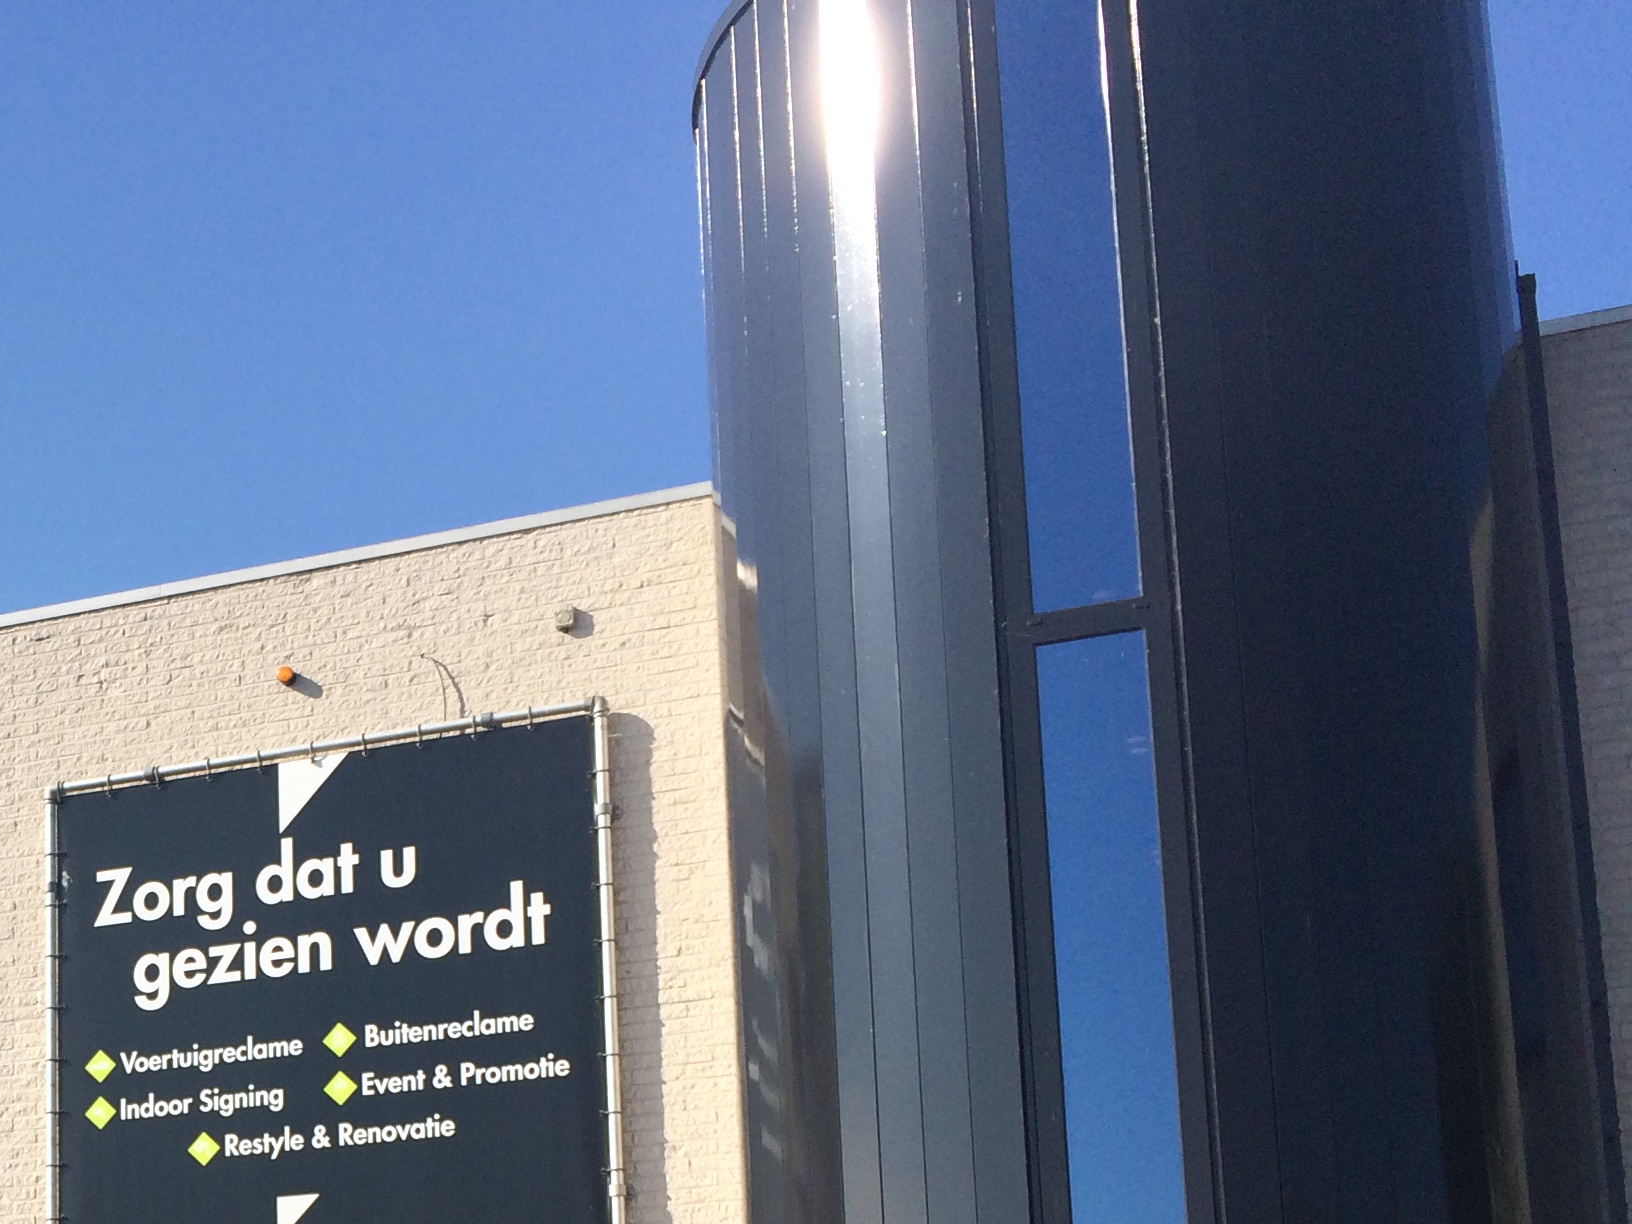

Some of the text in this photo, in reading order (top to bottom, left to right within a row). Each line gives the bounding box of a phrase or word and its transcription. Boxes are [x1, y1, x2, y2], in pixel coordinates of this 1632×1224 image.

[93, 837, 416, 931] Zorg dat u
[133, 880, 552, 1011] gezien wordt
[364, 1010, 535, 1048] Buitenreclame
[119, 1035, 304, 1075] Voertuigreclame
[361, 1053, 571, 1096] Event & Promotie
[120, 1084, 284, 1121] Indoor Signing
[224, 1114, 456, 1160] Restyle & Renovatie
